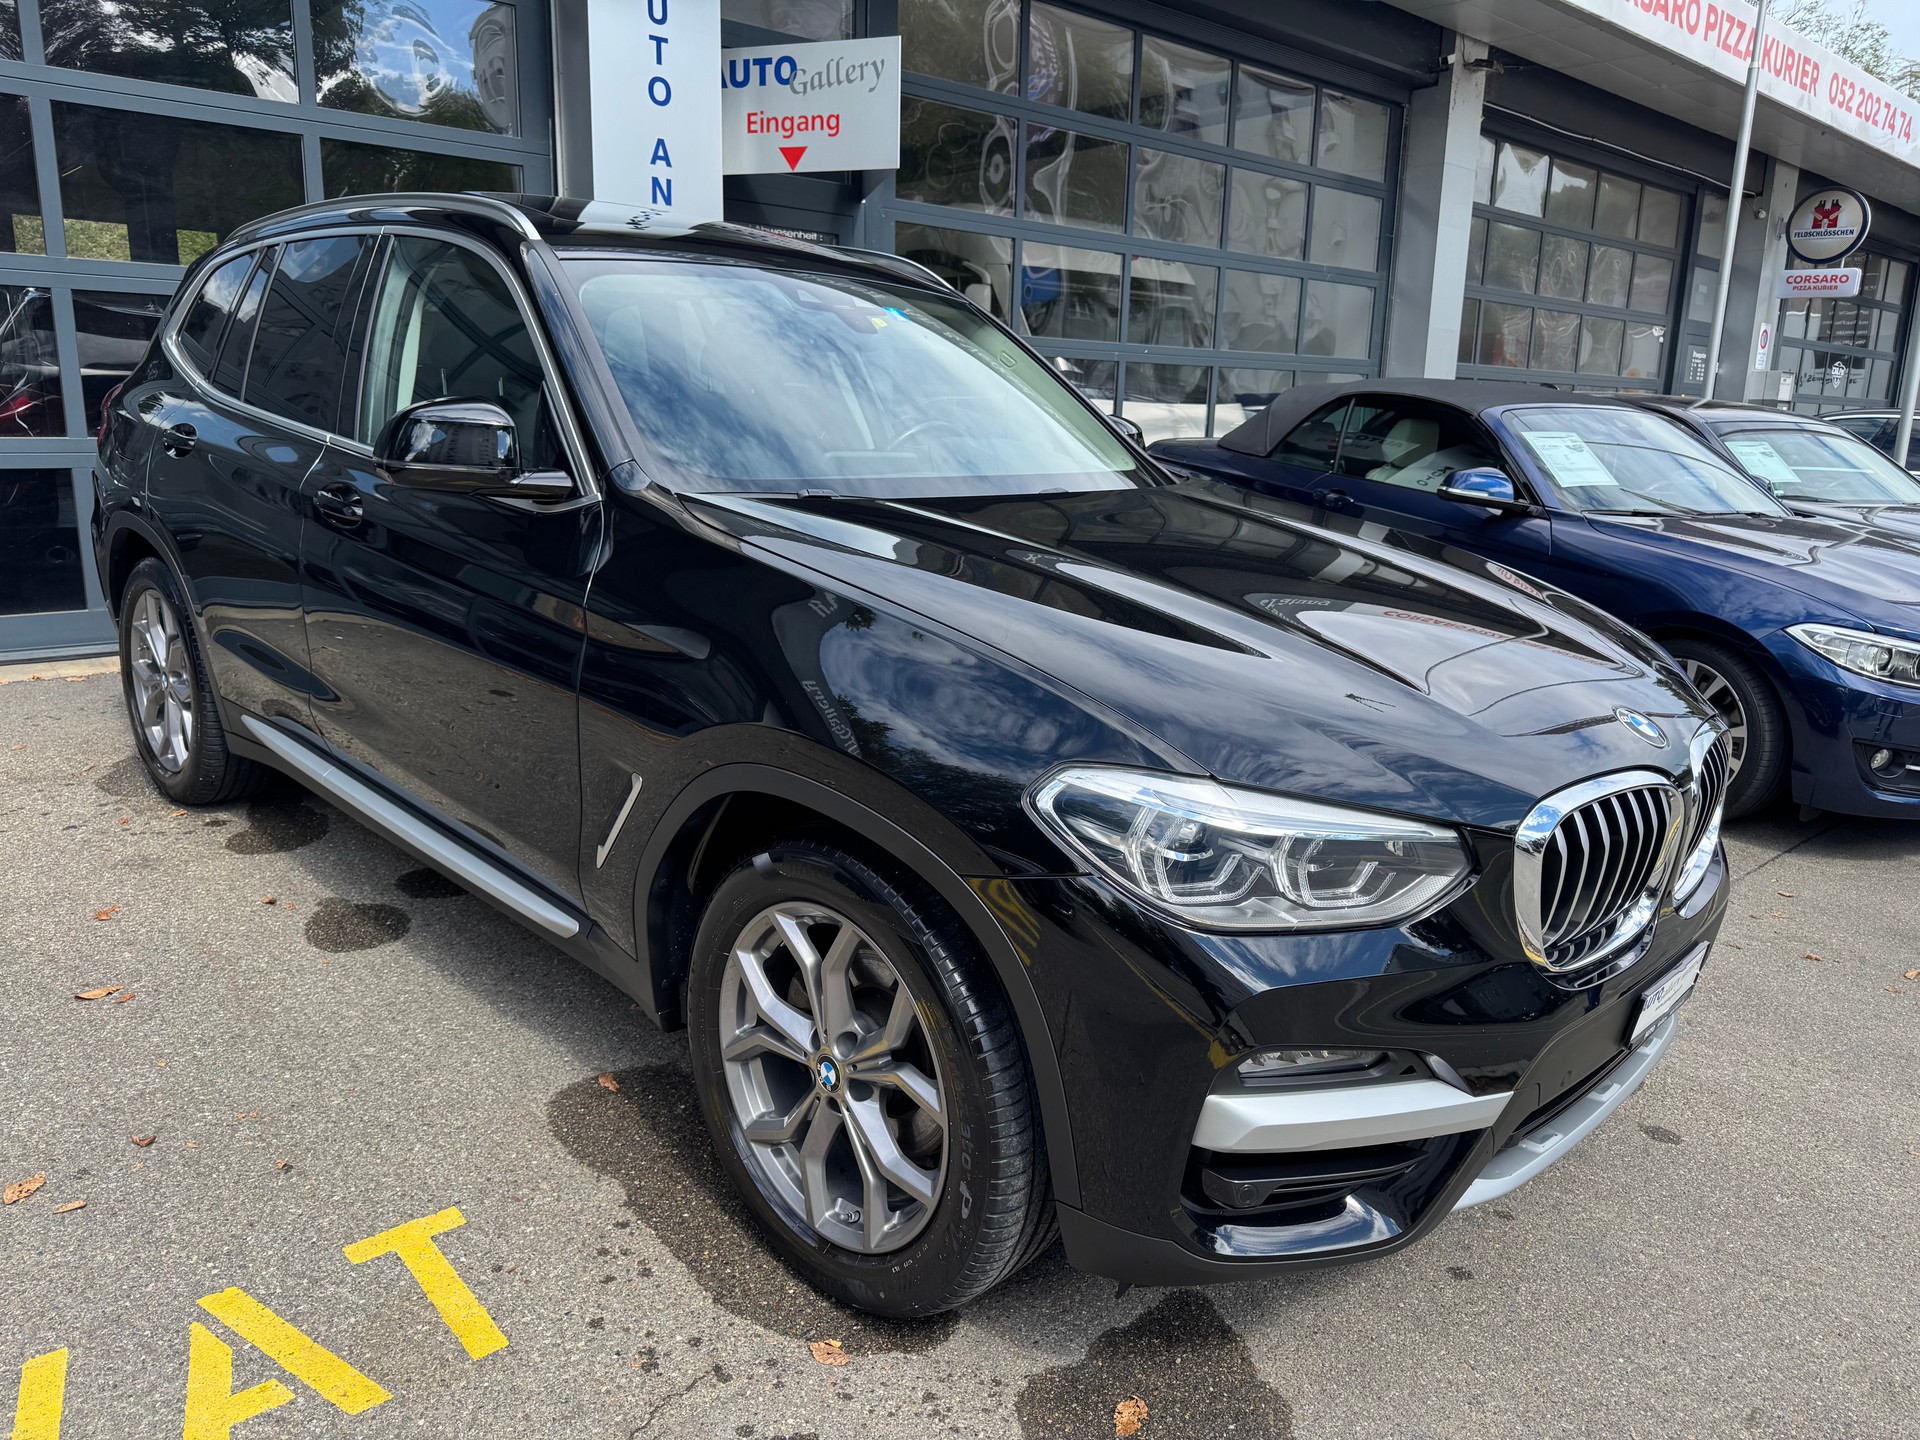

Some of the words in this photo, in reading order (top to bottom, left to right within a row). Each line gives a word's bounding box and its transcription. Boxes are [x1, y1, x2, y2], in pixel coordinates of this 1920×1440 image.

[722, 55, 797, 89] UTO
[788, 57, 885, 95] Gallery
[1761, 34, 1820, 97] KURIER
[1828, 72, 1856, 113] 052
[1855, 88, 1881, 127] 202
[1881, 101, 1897, 135] 74
[1897, 111, 1912, 143] 74
[746, 111, 840, 139] Eingang
[1794, 229, 1855, 239] FELDSCHLÖSSCHEN
[1786, 275, 1850, 285] CORSARO
